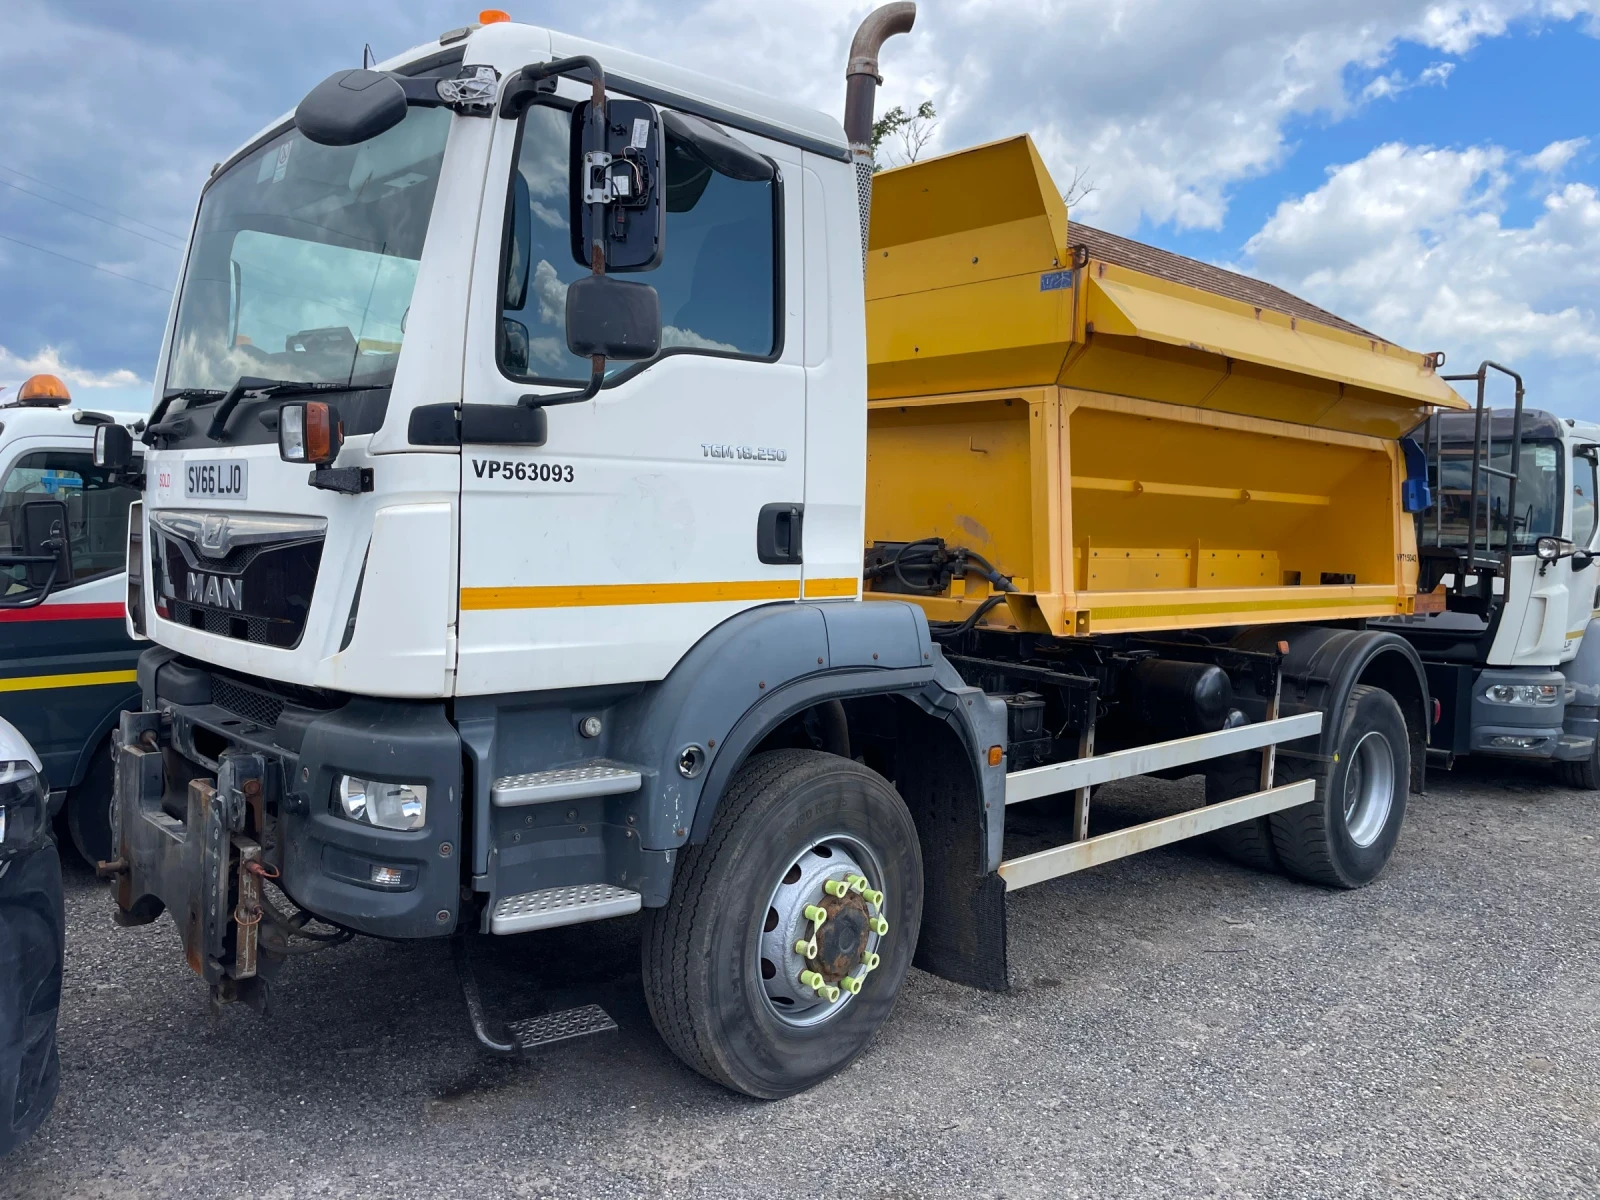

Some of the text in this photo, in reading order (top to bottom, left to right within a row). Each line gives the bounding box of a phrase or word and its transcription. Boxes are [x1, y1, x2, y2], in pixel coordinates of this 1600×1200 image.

[701, 443, 788, 462] TGM 18.250
[159, 473, 171, 488] SOLD
[471, 459, 575, 483] VP563093
[186, 571, 243, 611] MAN
